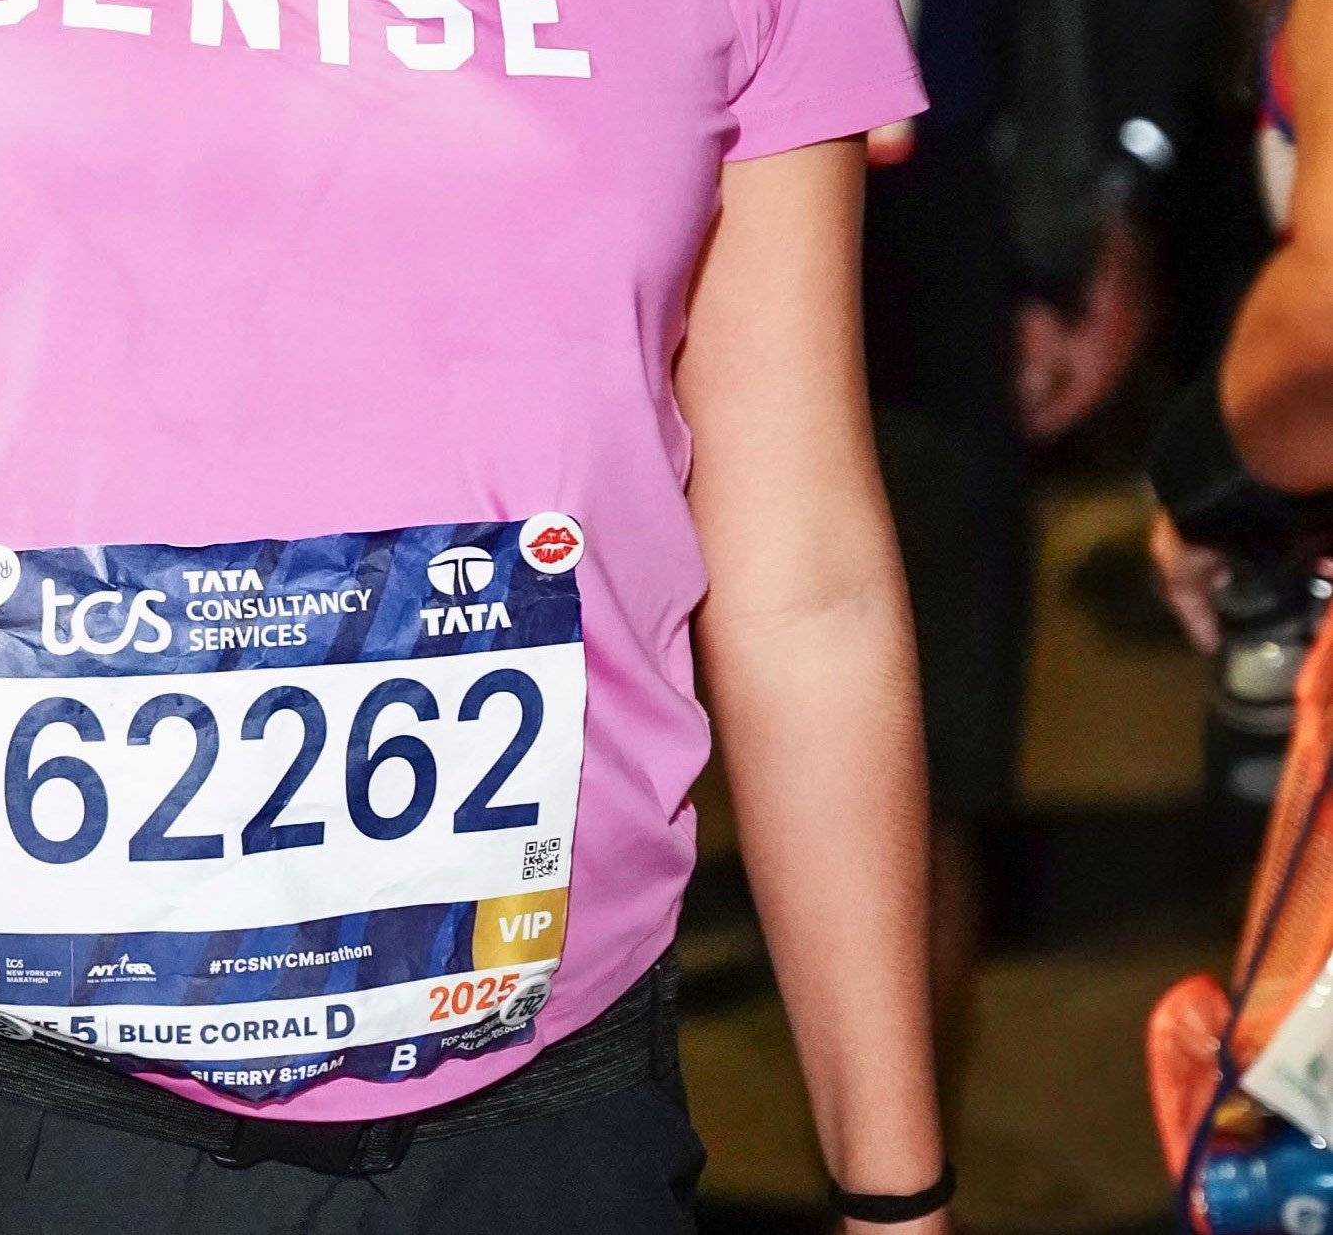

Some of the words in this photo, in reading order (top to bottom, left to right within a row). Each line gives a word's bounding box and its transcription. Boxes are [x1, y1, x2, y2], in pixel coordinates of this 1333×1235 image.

[182, 569, 264, 593] TATA
[41, 577, 173, 656] tcs
[185, 589, 372, 622] CONSULTANCY
[420, 603, 512, 637] TATA
[188, 623, 308, 652] SERVICES
[3, 668, 545, 865] 62262
[499, 910, 552, 943] VIP
[209, 944, 373, 975] #TCSNYCMarathon
[6, 976, 49, 984] MARATHON
[429, 973, 520, 1022] 2025
[70, 1015, 99, 1045] 5
[119, 1024, 192, 1045] BLUE
[200, 1016, 318, 1045] CORRAL
[326, 1004, 356, 1040] D
[213, 1068, 276, 1086] FERRY
[279, 1055, 345, 1083] 8:15AM
[390, 1044, 417, 1072] B
